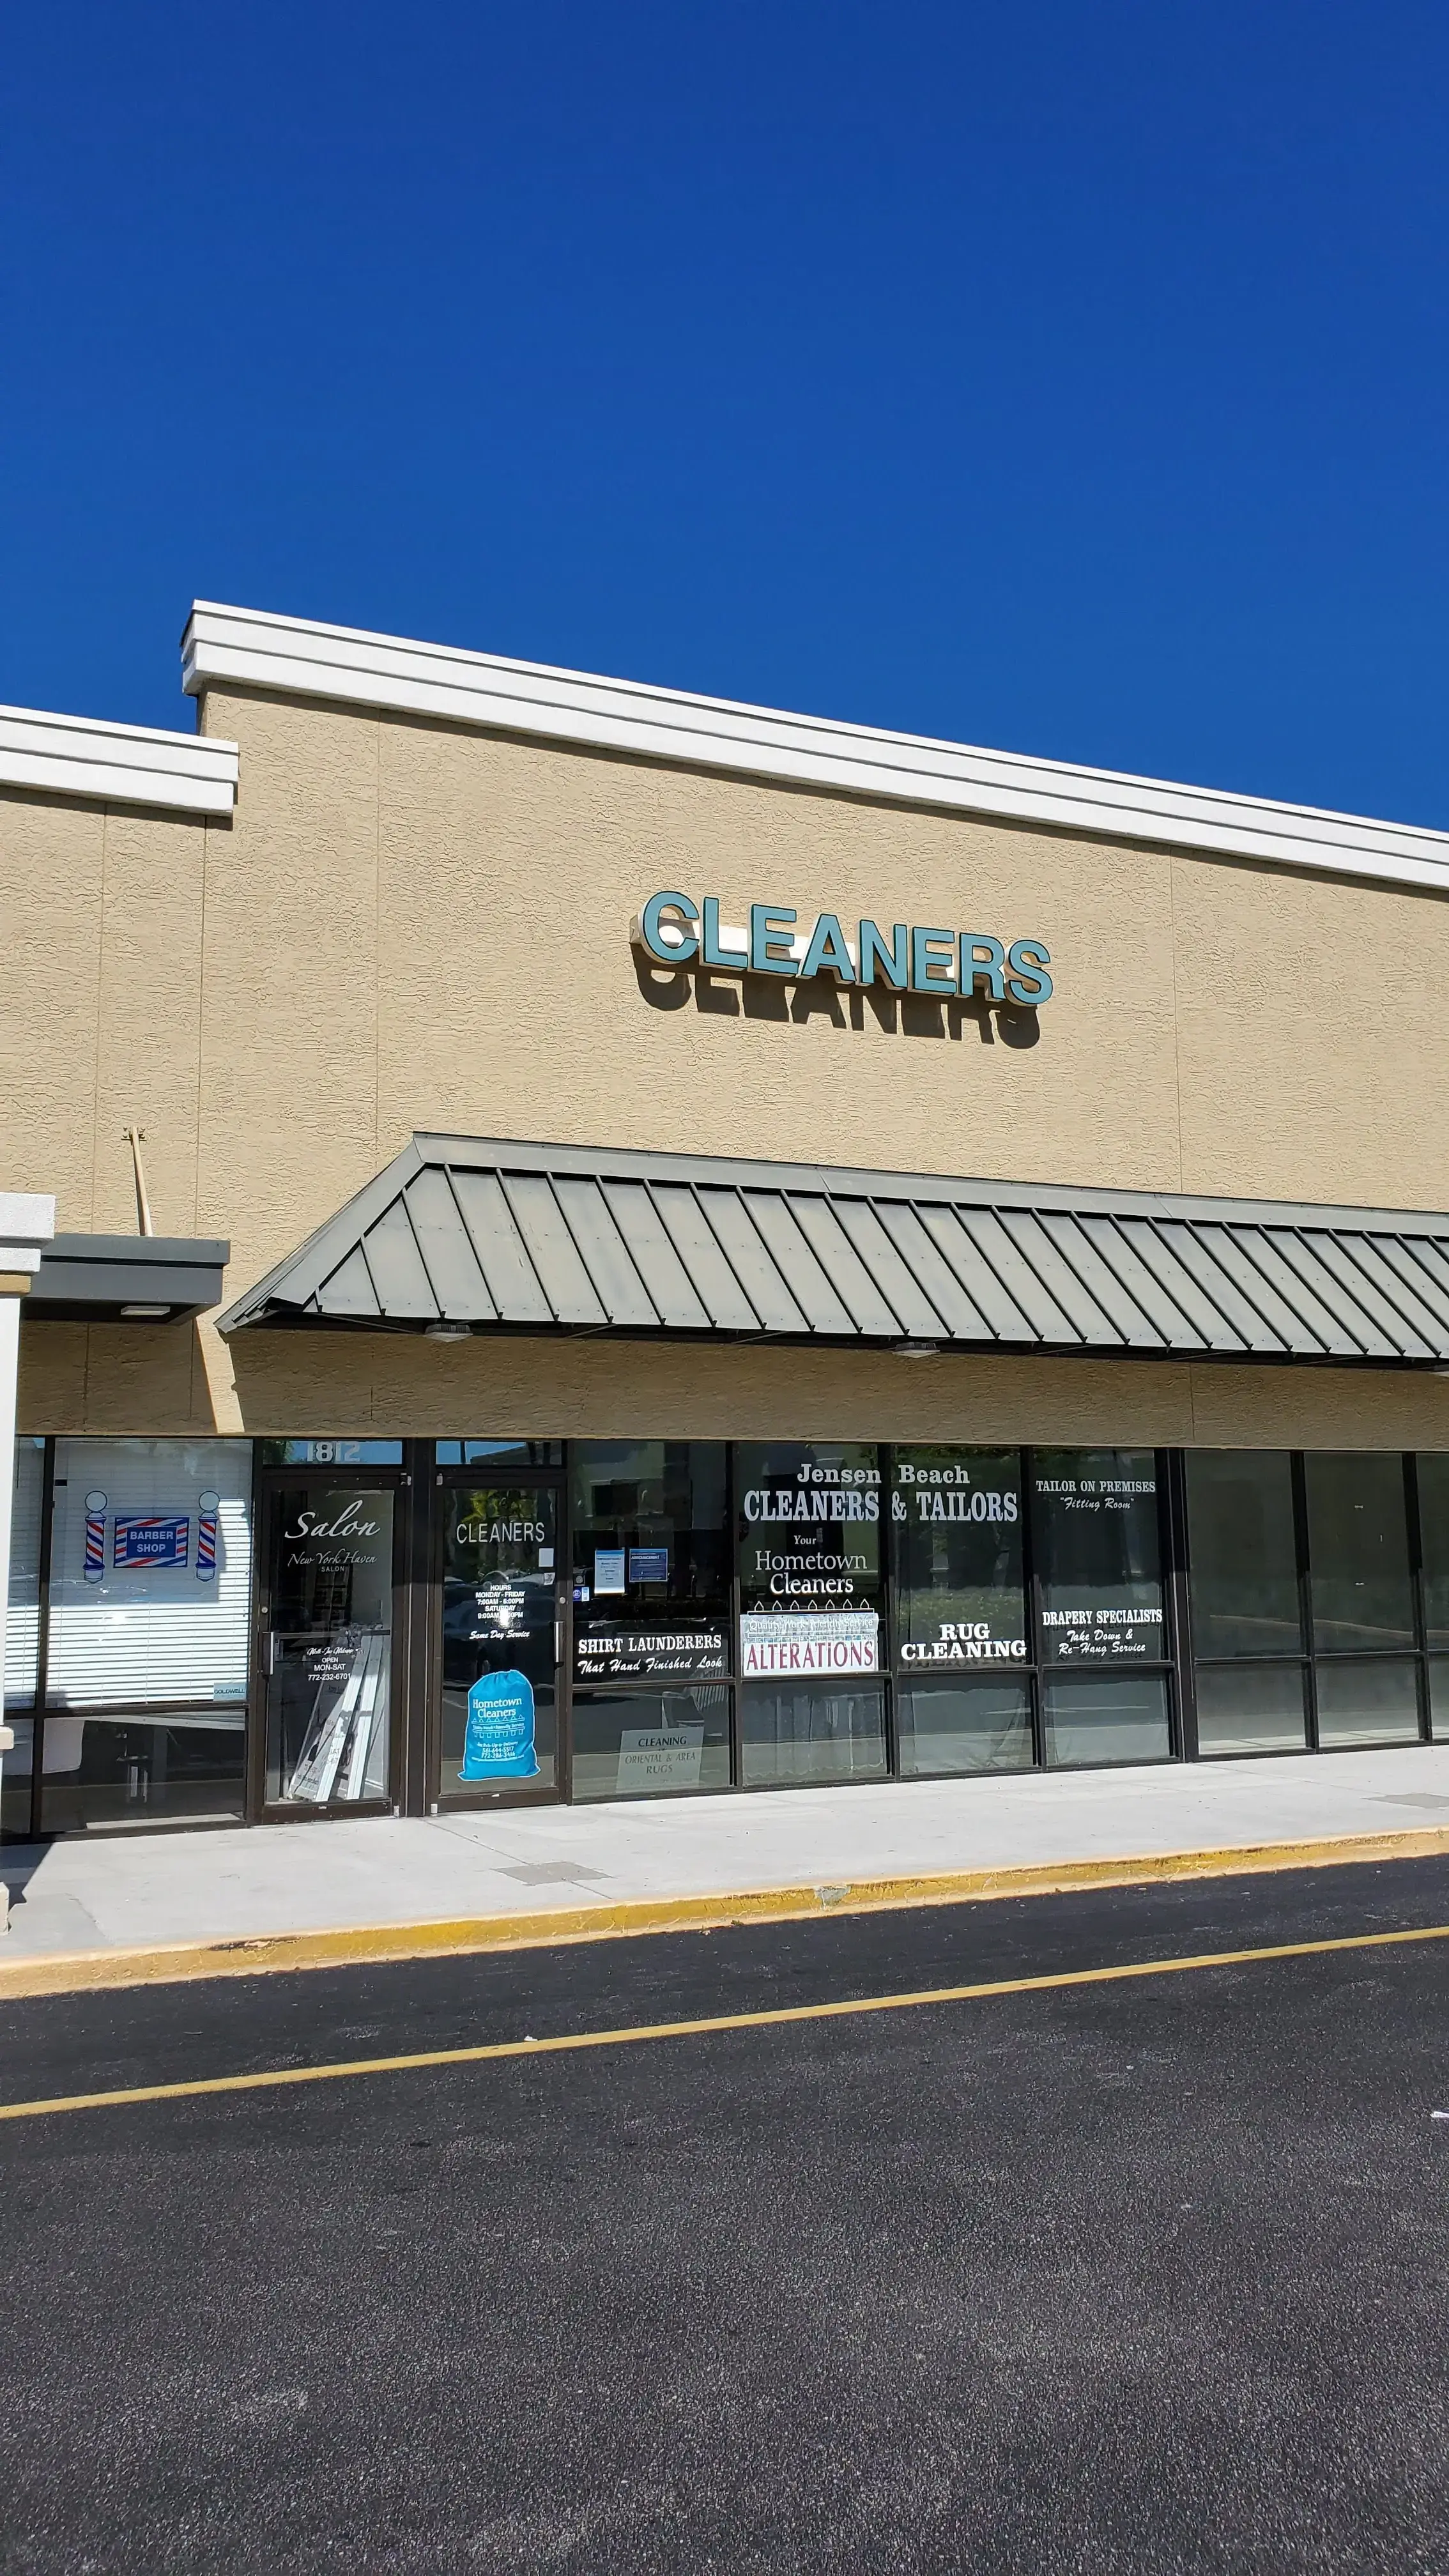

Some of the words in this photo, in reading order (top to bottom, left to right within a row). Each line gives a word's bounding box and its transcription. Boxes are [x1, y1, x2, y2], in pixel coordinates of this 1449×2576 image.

[640, 891, 1053, 1006] CLEANERS
[307, 1441, 360, 1462] 1812
[797, 1463, 882, 1483] Jensen
[898, 1464, 970, 1483] Beach
[1036, 1480, 1077, 1492] TAILOR
[1080, 1480, 1096, 1492] ON
[1100, 1481, 1156, 1492] PREMISES
[744, 1490, 880, 1521] CLEANERS
[892, 1491, 907, 1521] &
[916, 1491, 1018, 1522] TAILORS
[1060, 1496, 1101, 1512] "Fitting
[1105, 1497, 1135, 1509] Room"
[284, 1499, 381, 1538] Salon
[130, 1531, 174, 1540] BARBER
[456, 1522, 545, 1544] CLEANERS
[793, 1535, 816, 1545] Your
[137, 1544, 166, 1552] SHOP
[288, 1551, 315, 1567] New
[316, 1548, 346, 1565] York
[343, 1550, 378, 1564] Haven
[755, 1550, 868, 1570] Hometown
[770, 1572, 854, 1594] Cleaners
[749, 1619, 779, 1631] Quality
[844, 1618, 873, 1627] Service
[1042, 1611, 1093, 1625] DRAPERY
[1096, 1609, 1163, 1623] SPECIALISTS
[469, 1630, 489, 1639] Same
[939, 1623, 990, 1641] RUG
[1066, 1630, 1090, 1643] Take
[1093, 1629, 1121, 1641] Down
[1125, 1628, 1133, 1639] &
[578, 1638, 624, 1654] SHIRT
[629, 1634, 722, 1652] LAUNDERERS
[901, 1639, 1027, 1660] CLEANING
[1059, 1643, 1107, 1656] Re-Hang
[1112, 1641, 1146, 1653] Service
[746, 1641, 873, 1670] ALTERATIONS
[314, 1663, 346, 1671] MON-SAT
[578, 1659, 605, 1675] That
[610, 1658, 641, 1672] Hand
[645, 1656, 693, 1673] Finished
[696, 1655, 723, 1668] Look
[473, 1698, 522, 1708] Hometown
[477, 1708, 516, 1718] Cleaners
[639, 1736, 687, 1747] CLEANING
[625, 1754, 663, 1764] ORIENTAL
[666, 1754, 671, 1762] &
[677, 1752, 696, 1761] AREA
[647, 1765, 673, 1774] RUGS
